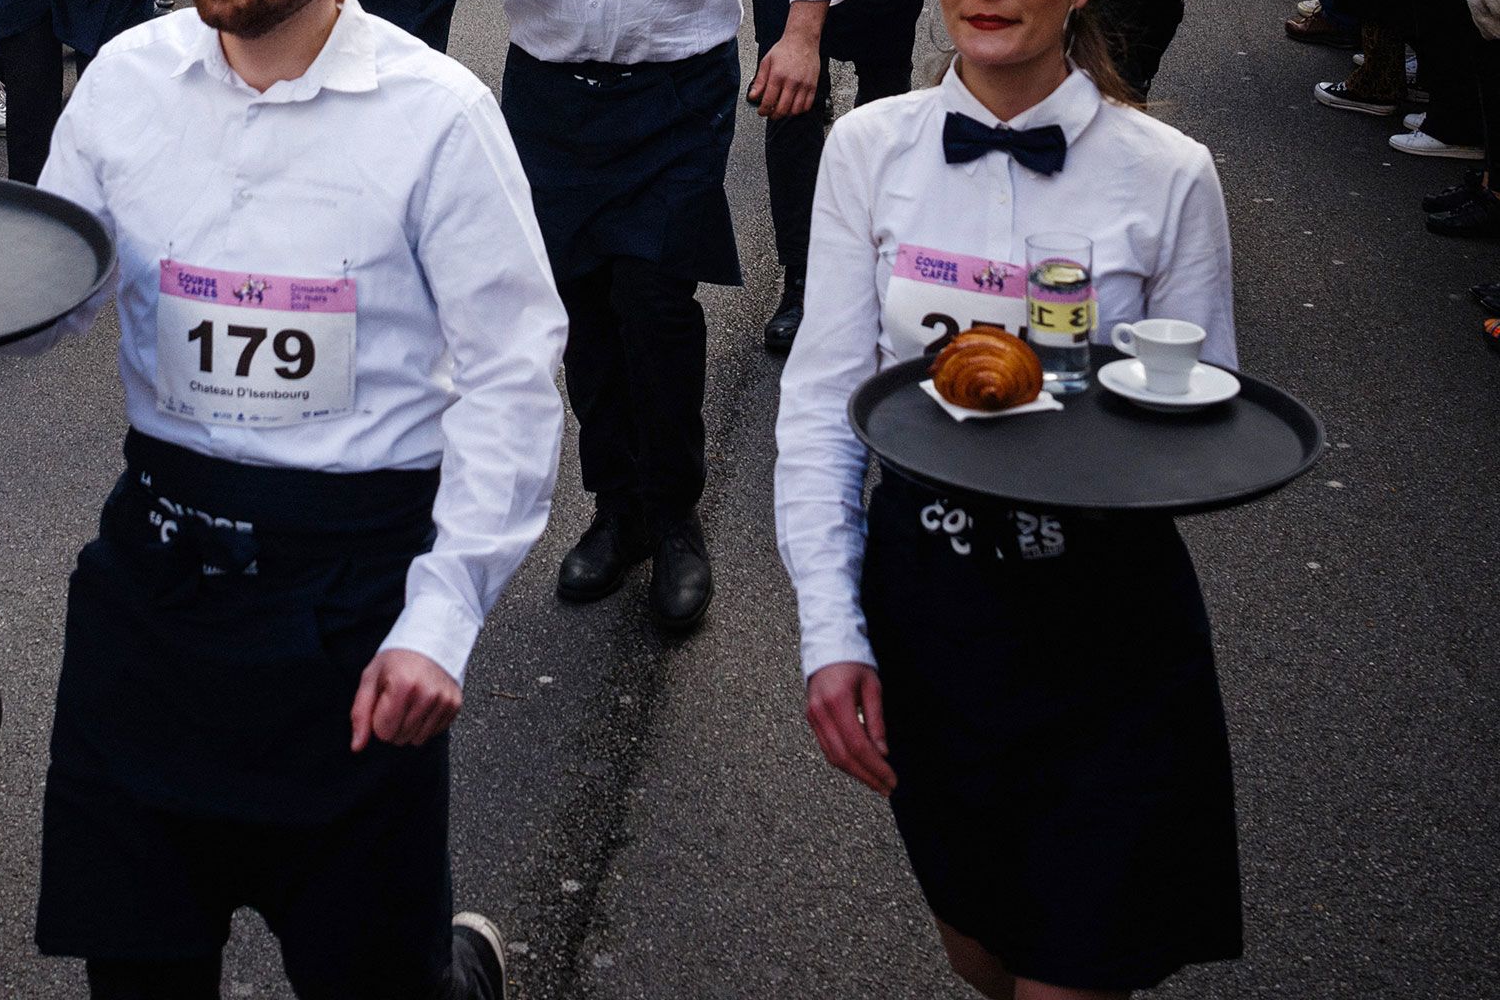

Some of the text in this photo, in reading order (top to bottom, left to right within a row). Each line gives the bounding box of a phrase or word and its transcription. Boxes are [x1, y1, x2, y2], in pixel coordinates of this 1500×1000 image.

[915, 256, 959, 271] COURSE
[178, 271, 339, 294] COURSE Dimanche
[188, 319, 317, 381] 179
[190, 379, 311, 400] Chateau D'Isenbourg
